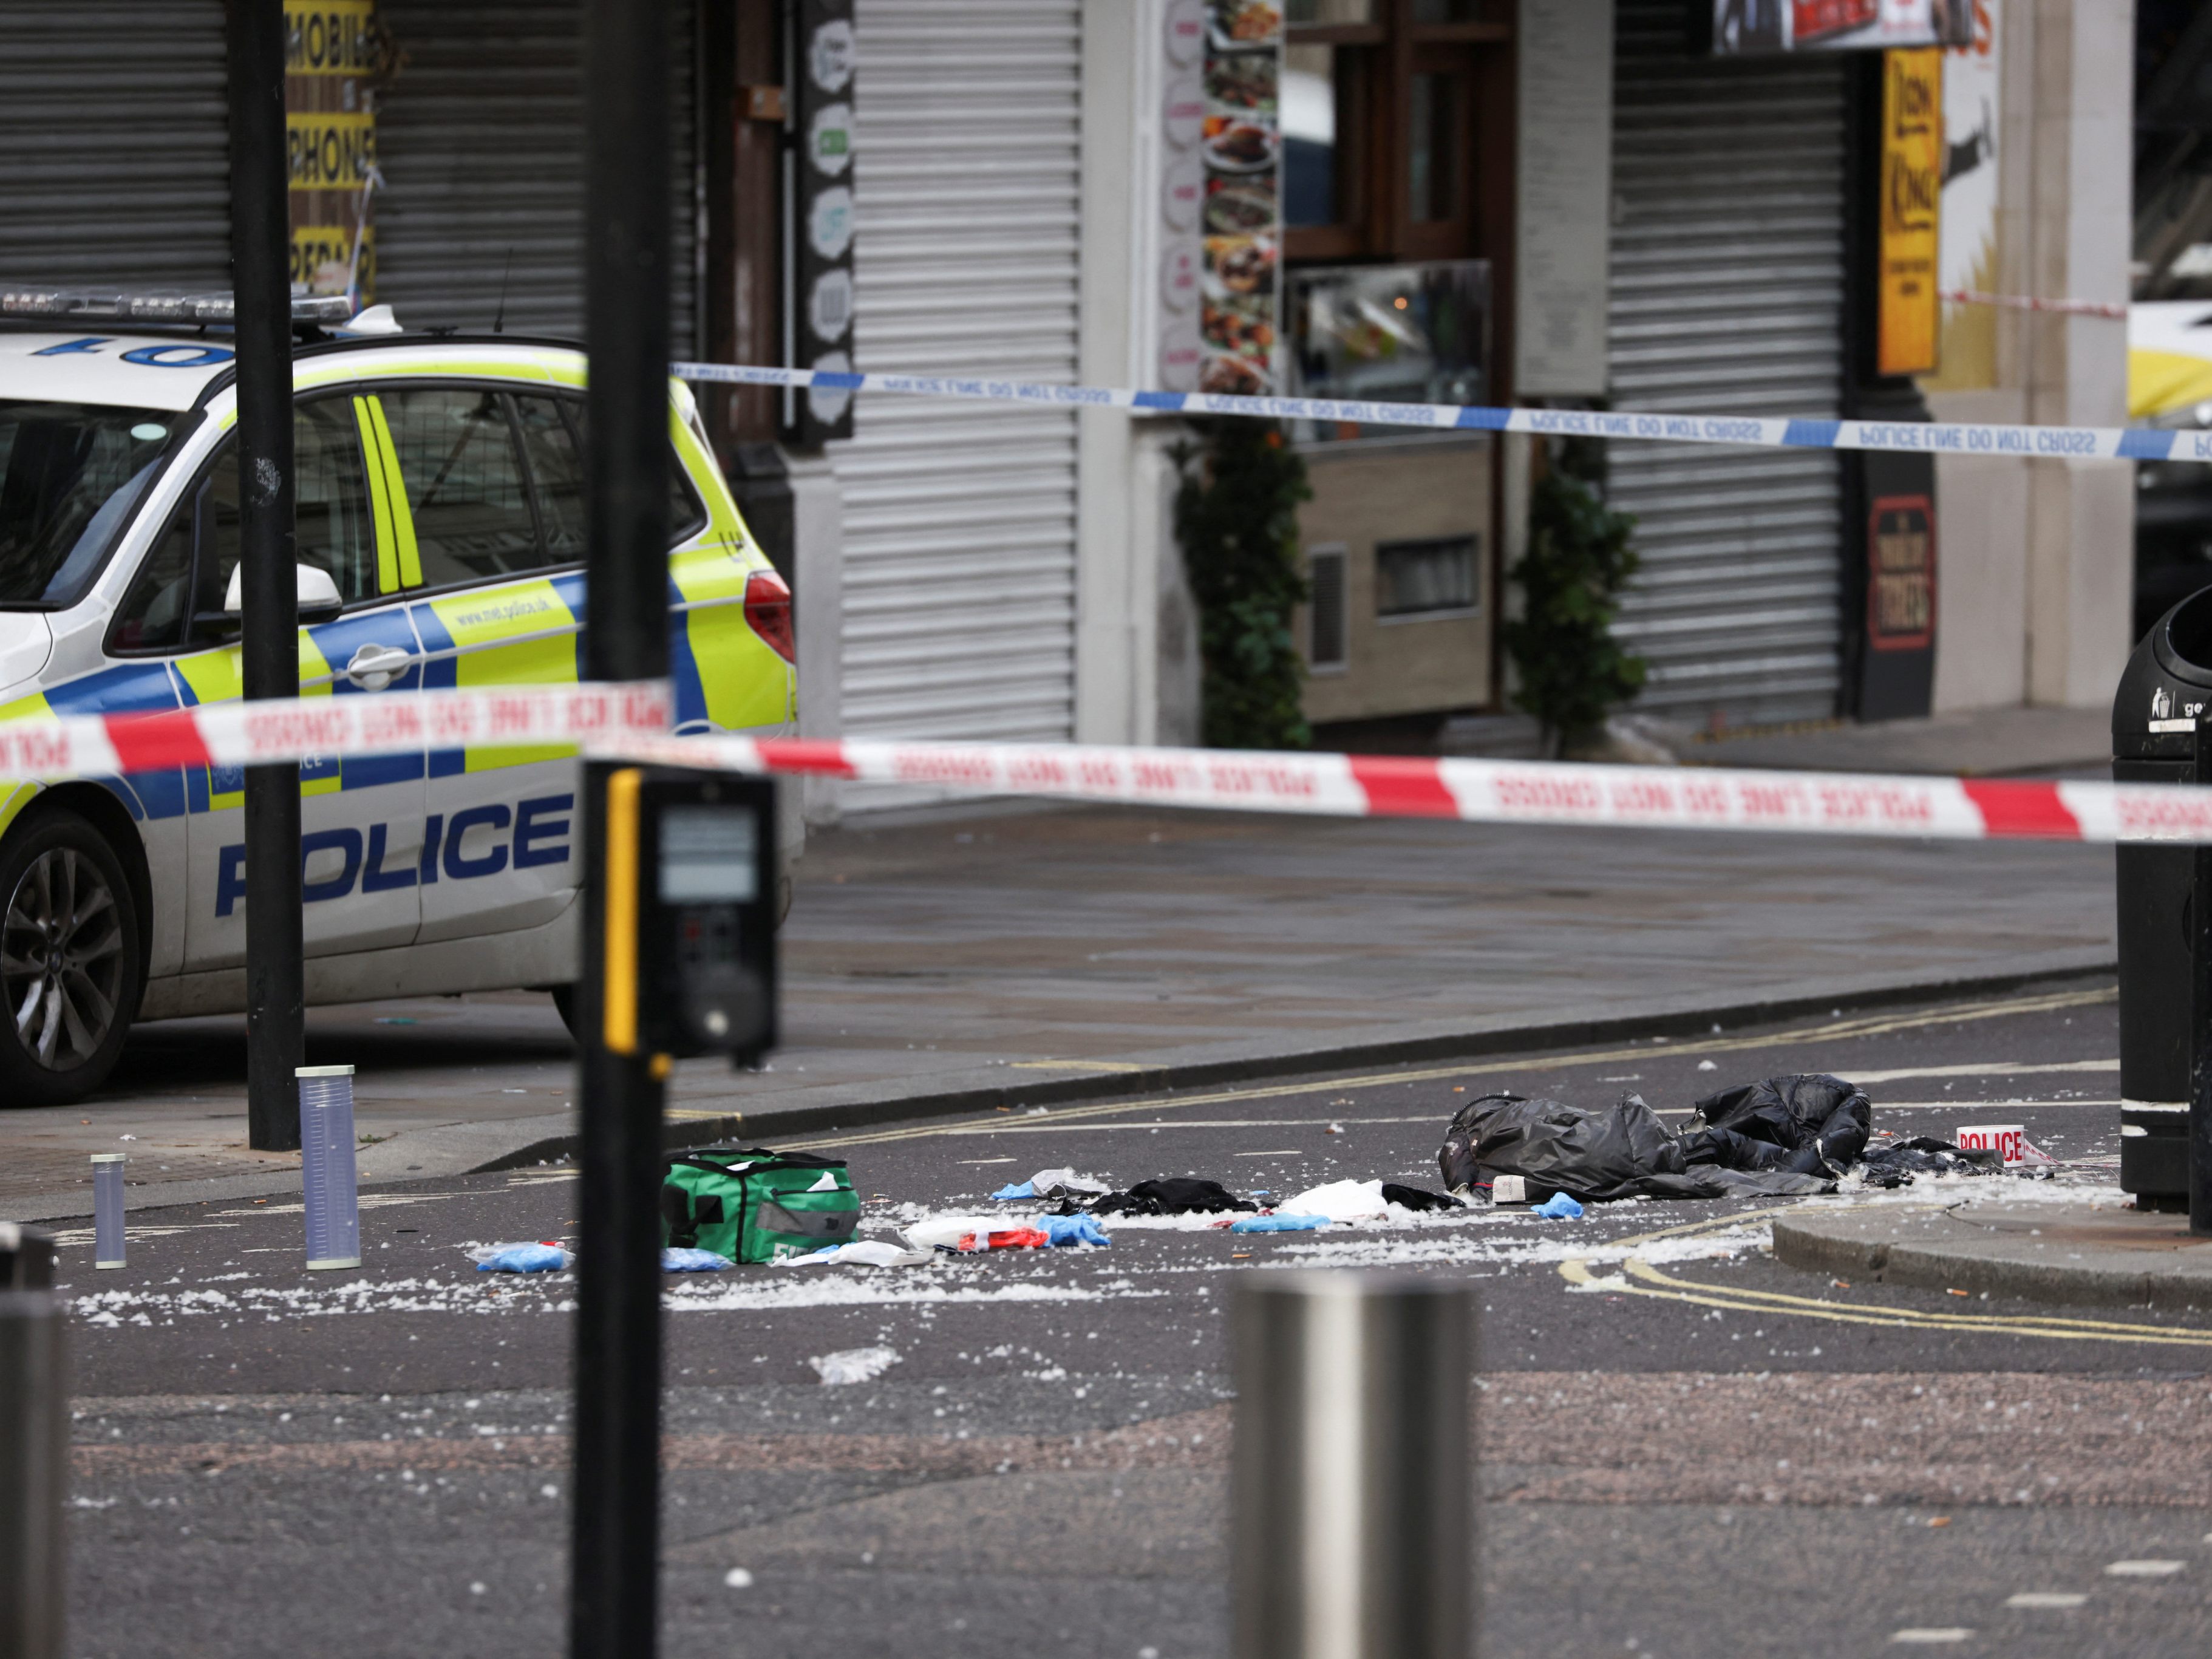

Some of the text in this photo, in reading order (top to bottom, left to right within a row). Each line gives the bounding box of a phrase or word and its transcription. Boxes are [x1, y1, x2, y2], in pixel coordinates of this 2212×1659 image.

[284, 12, 375, 68] MOBILE
[289, 128, 374, 183] PHONE
[455, 597, 551, 626] www.met.police.uk
[215, 793, 574, 918] POLICE
